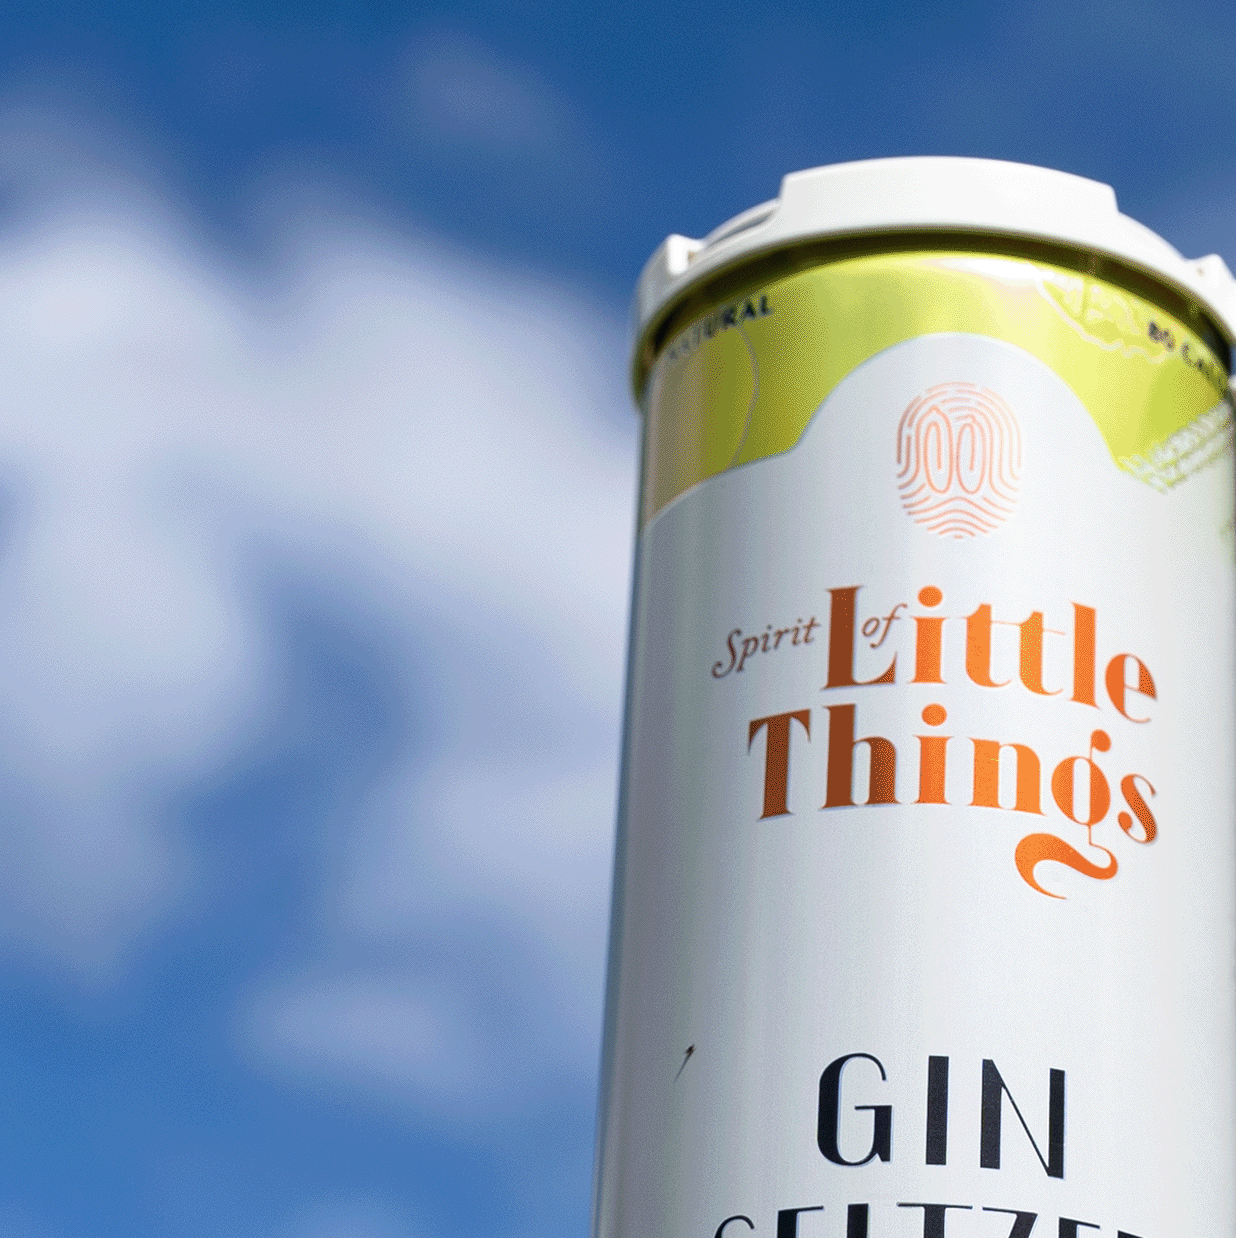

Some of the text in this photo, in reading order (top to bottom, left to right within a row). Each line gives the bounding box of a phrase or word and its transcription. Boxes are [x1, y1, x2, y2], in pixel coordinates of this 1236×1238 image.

[710, 584, 1159, 723] Spirit of Little
[746, 702, 1159, 900] Things
[816, 1051, 1067, 1180] GIN
